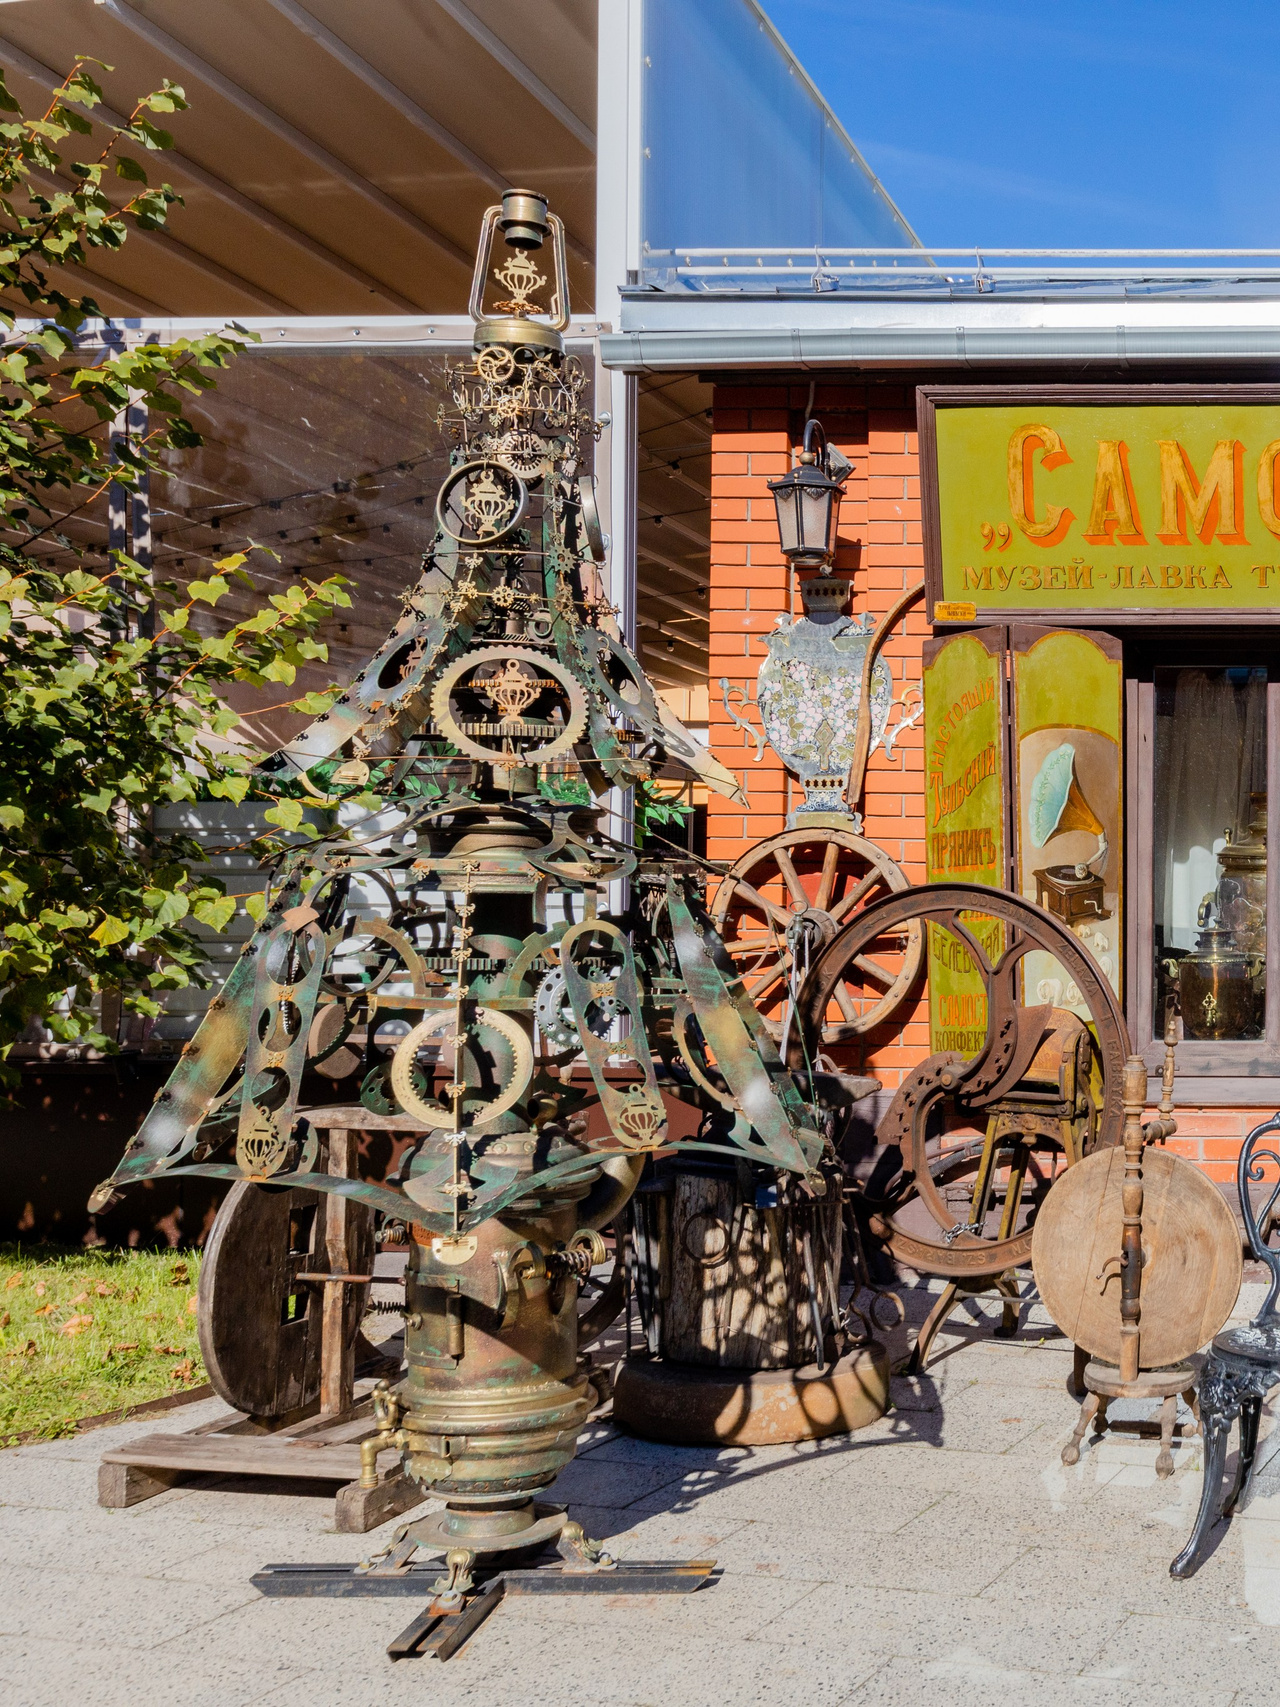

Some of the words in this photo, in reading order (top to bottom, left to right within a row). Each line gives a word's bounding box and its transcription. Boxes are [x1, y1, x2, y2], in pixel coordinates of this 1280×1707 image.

[962, 557, 1232, 591] МУЗЕЙ-ЛАВКА
[932, 922, 1000, 973] БЕЛЕВАЯ
[939, 993, 988, 1028] СЛАДОСТ
